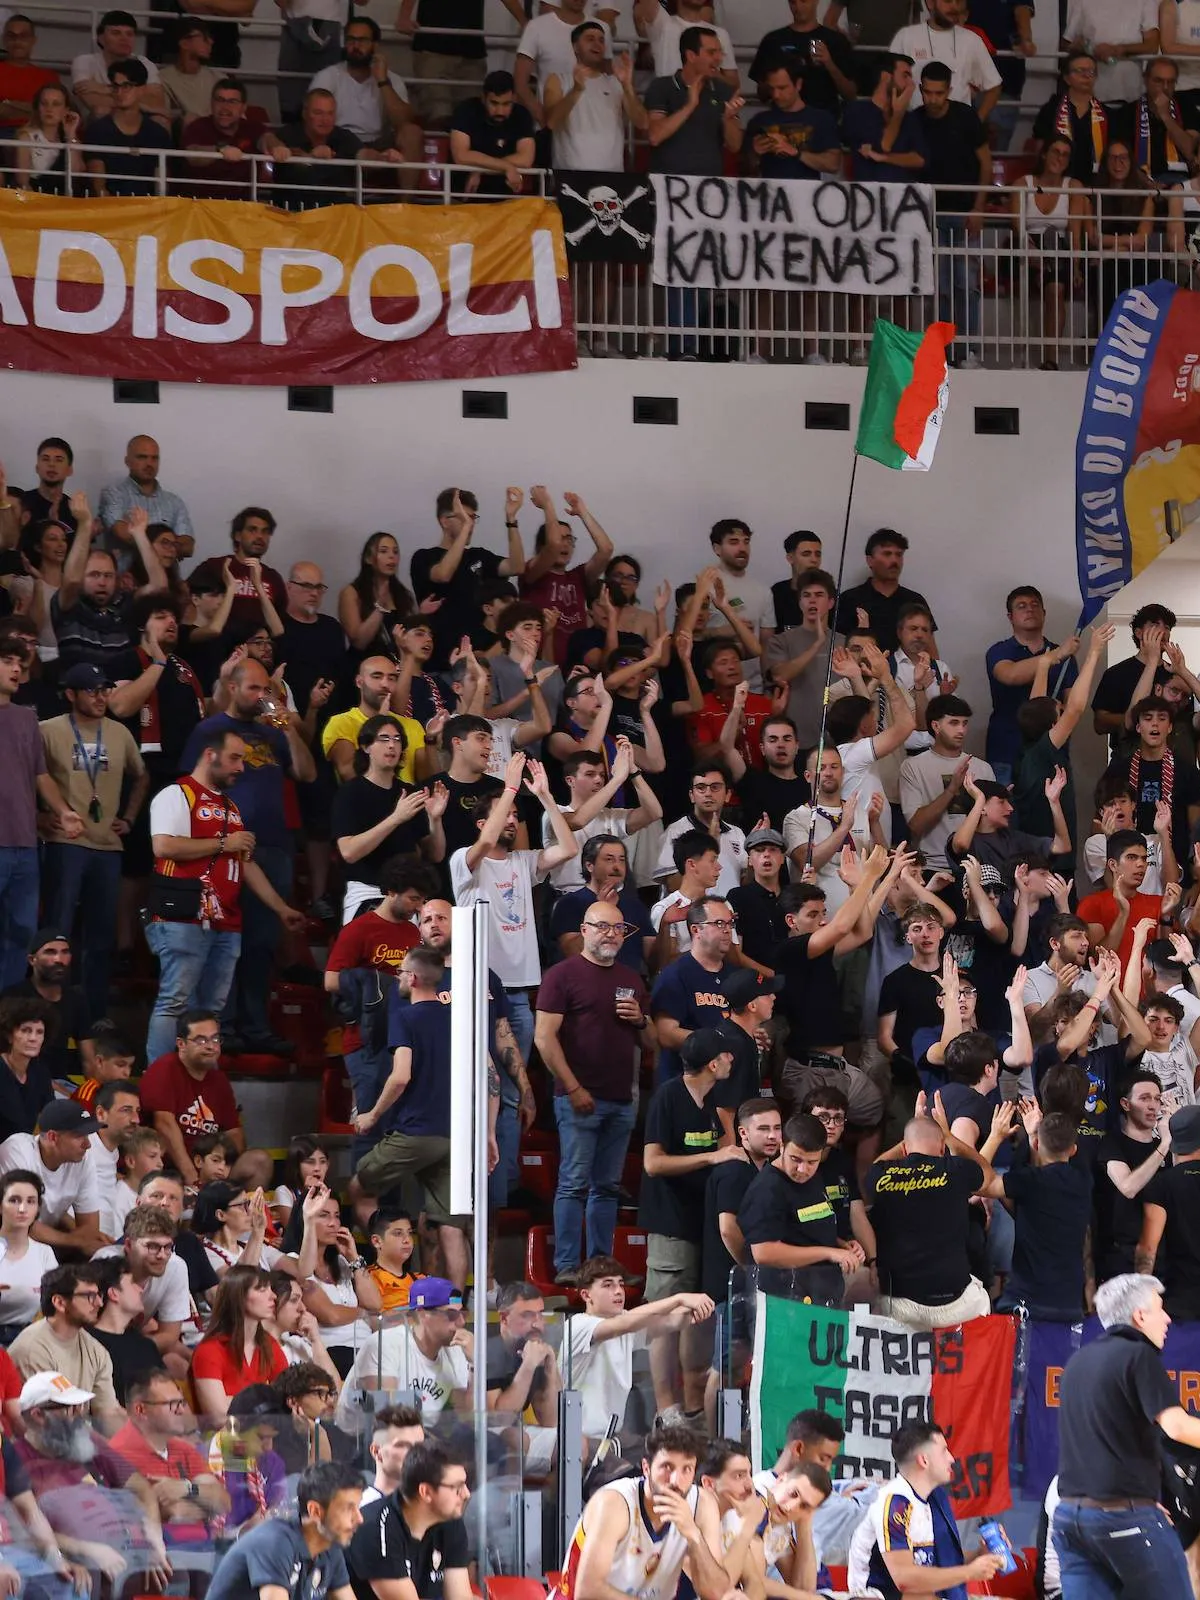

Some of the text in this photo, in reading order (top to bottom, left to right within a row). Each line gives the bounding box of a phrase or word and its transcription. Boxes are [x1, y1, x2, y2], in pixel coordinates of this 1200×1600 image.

[664, 175, 932, 233] ROMA ODIA
[666, 225, 921, 294] KAUKENAS!
[875, 1171, 948, 1197] Campioni
[808, 1319, 964, 1376] ULTRAS
